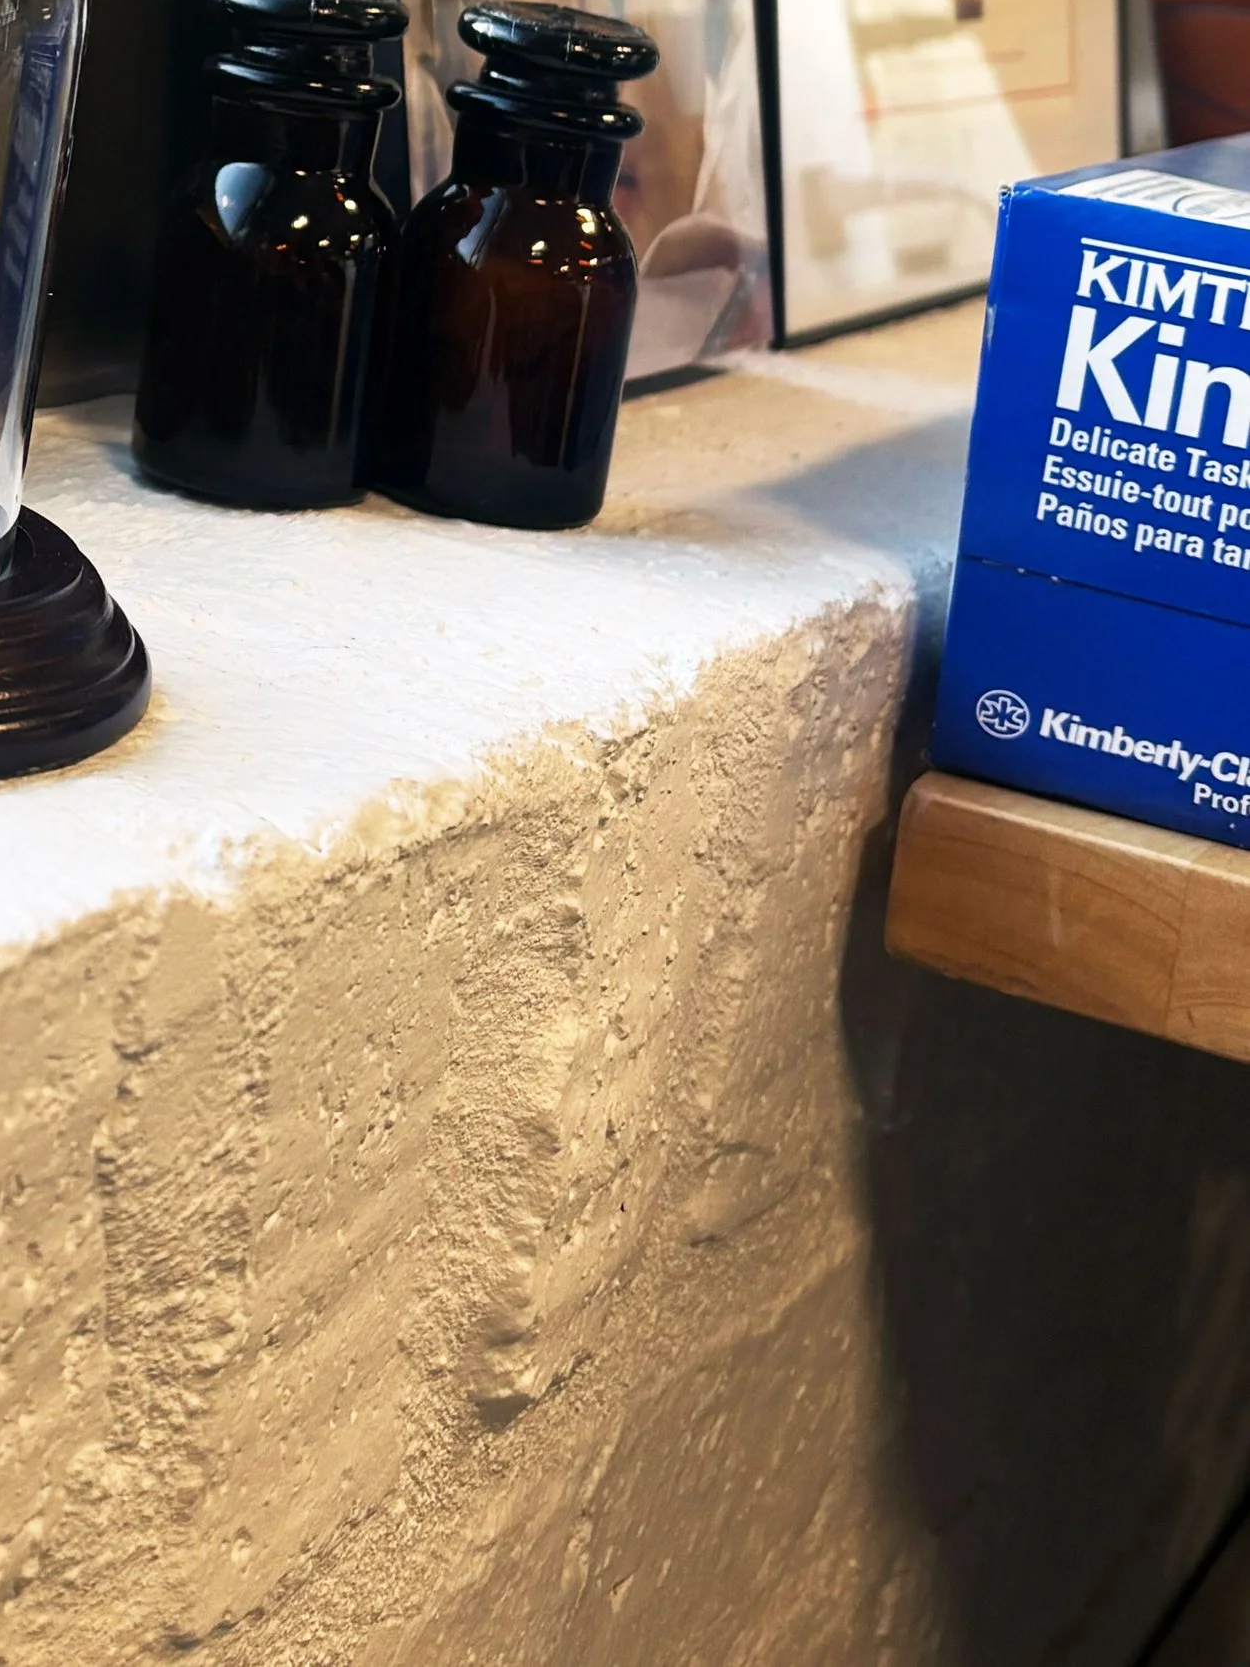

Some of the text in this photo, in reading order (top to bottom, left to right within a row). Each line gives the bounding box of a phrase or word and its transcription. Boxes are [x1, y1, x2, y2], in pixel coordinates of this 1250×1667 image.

[1075, 249, 1250, 332] KIMT
[1049, 416, 1177, 472] Delicate
[1042, 454, 1214, 522] Essuie-tout
[1036, 491, 1128, 540] Paños
[1134, 523, 1204, 559] para
[1039, 707, 1250, 788] Kimberly-Cl
